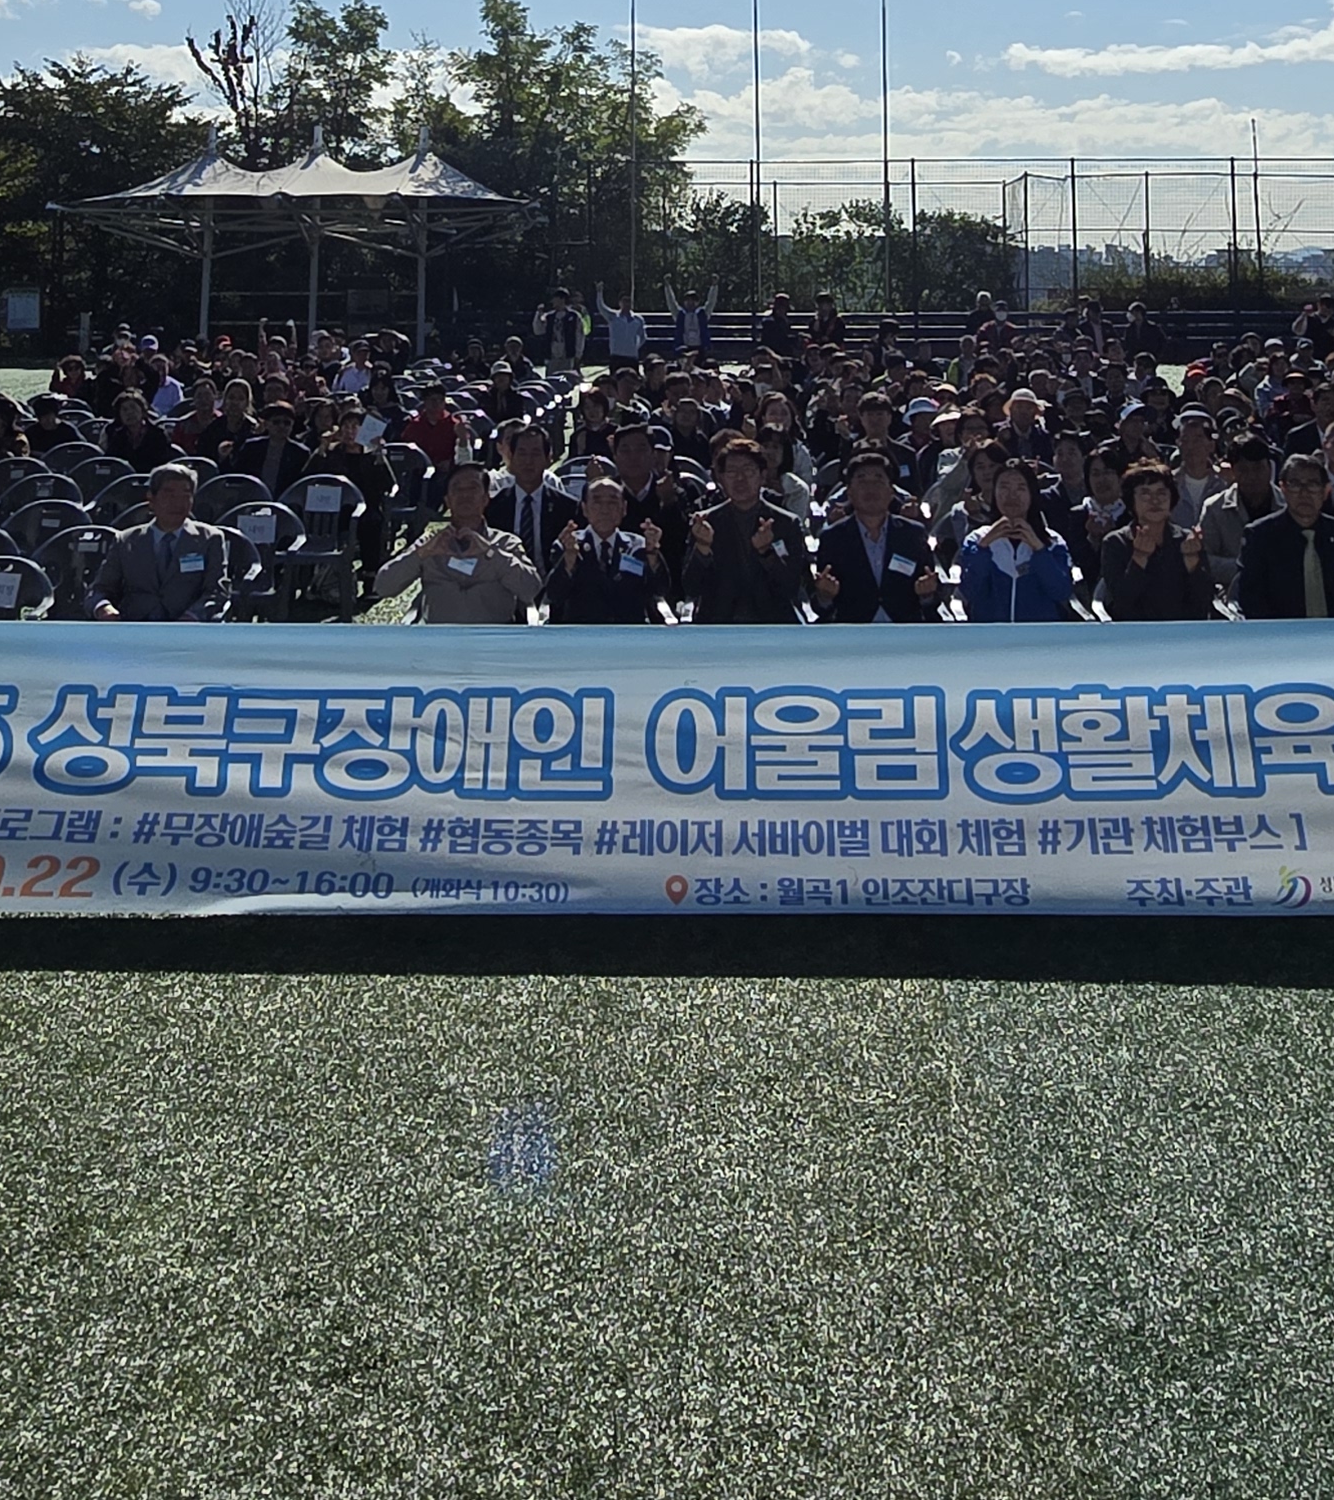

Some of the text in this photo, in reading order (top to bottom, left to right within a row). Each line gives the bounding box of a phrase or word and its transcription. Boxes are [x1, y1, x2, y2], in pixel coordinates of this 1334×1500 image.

[27, 684, 614, 802] 성북구장애인
[645, 686, 949, 801] 어울림
[132, 812, 332, 851] #무장애숲길
[337, 815, 410, 853] 체험
[419, 817, 584, 856] #협동종목
[594, 819, 724, 857] #레이저
[731, 819, 870, 857] 서바이벌
[880, 819, 949, 857] 대회
[956, 818, 1028, 857] 체험
[1038, 817, 1135, 855] #기관
[1141, 812, 1285, 854] 체험부스
[112, 861, 178, 896] (수)
[188, 866, 395, 899] 9:30~16:00
[693, 877, 751, 906] 장소
[777, 876, 850, 906] 월곡1
[862, 877, 1030, 907] 인조잔디구장
